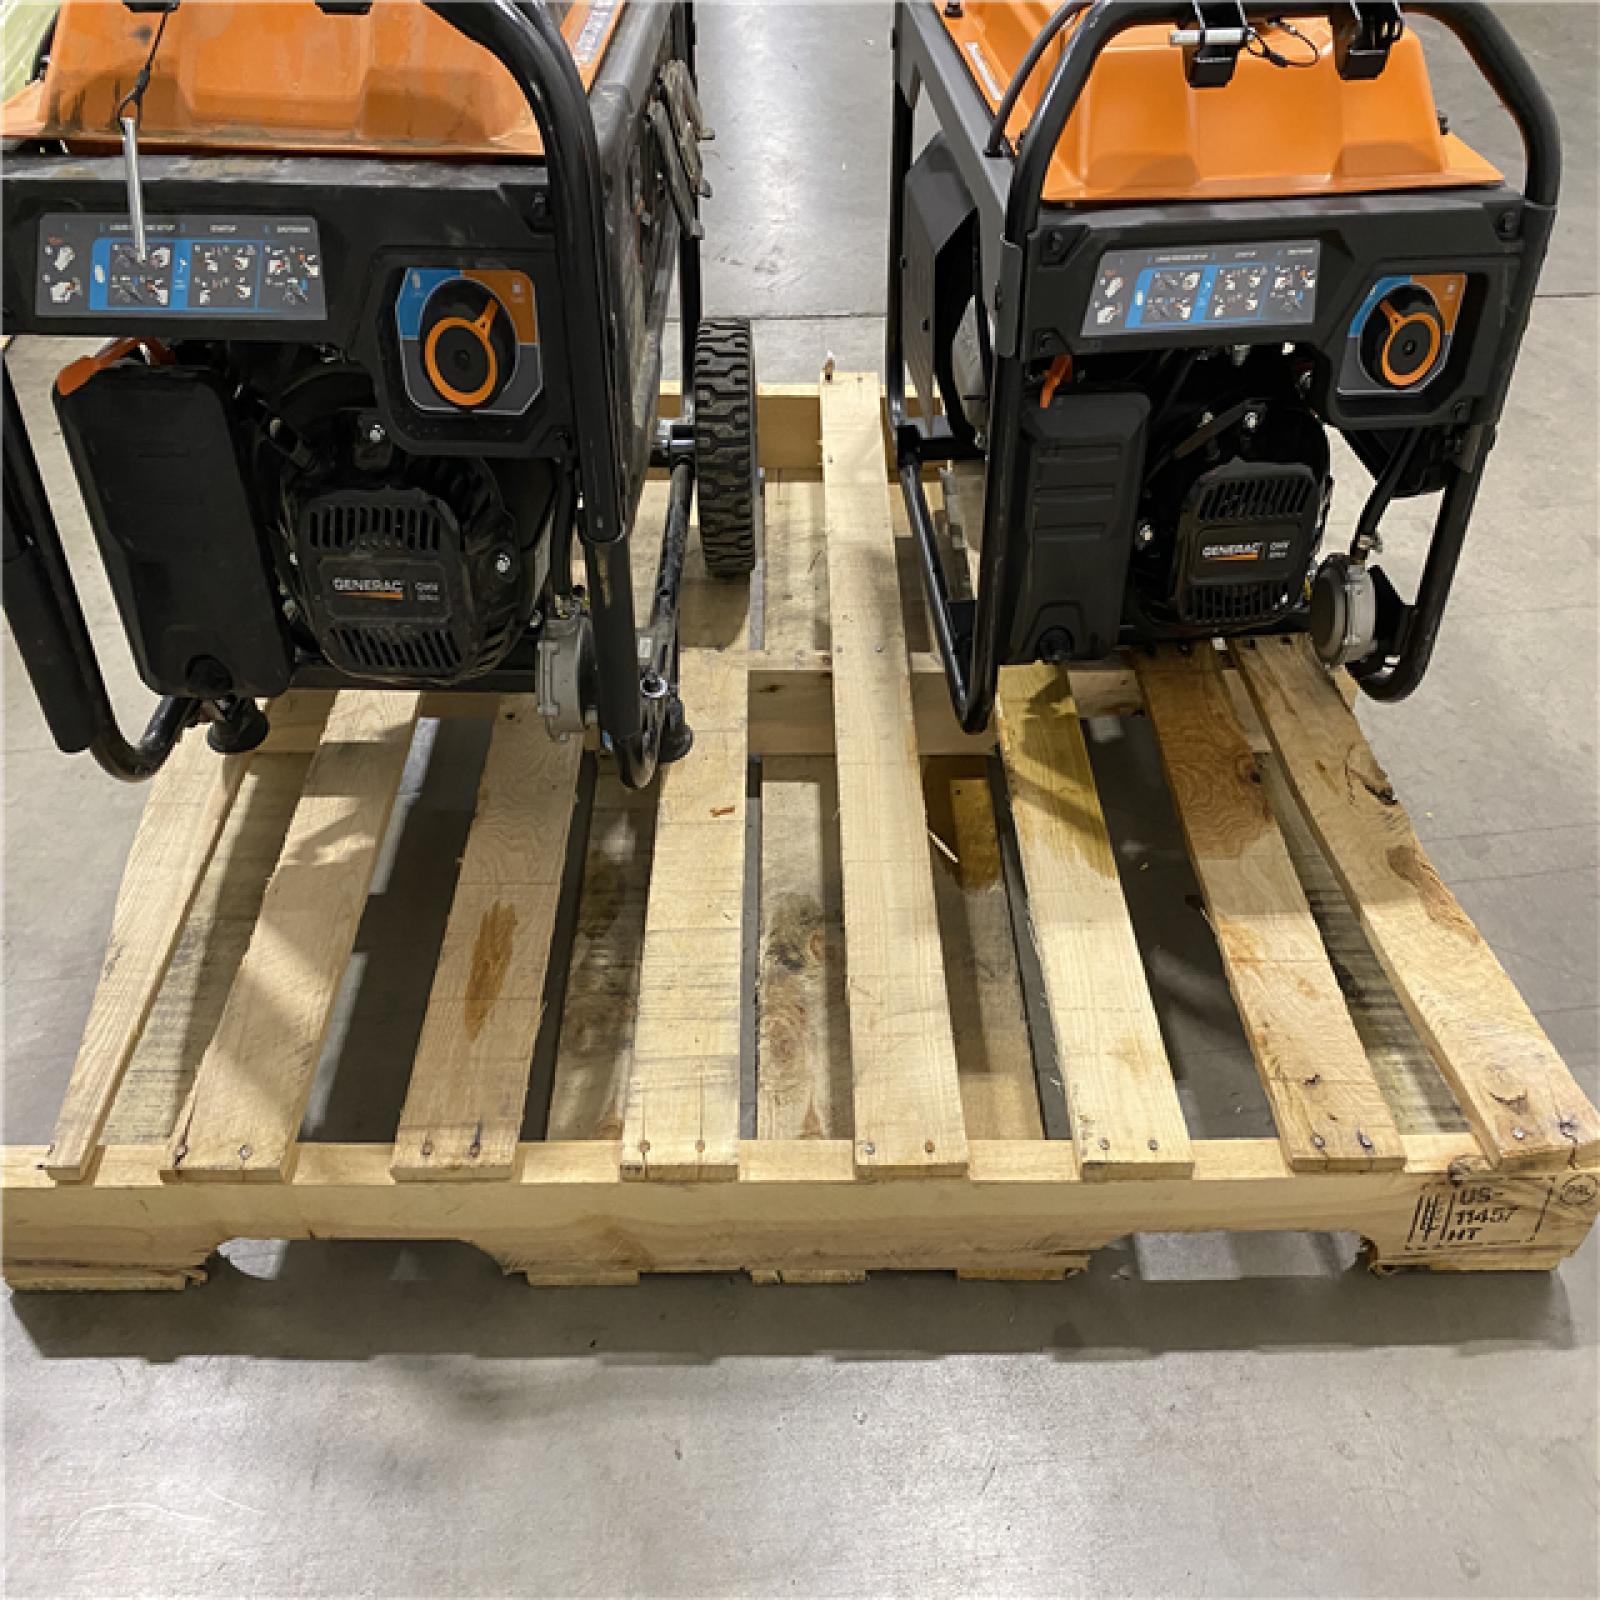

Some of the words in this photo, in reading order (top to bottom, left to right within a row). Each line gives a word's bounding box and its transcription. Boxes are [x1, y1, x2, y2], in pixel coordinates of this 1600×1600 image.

[1202, 543, 1262, 557] GENERAC
[334, 577, 403, 592] GENERAC
[1456, 1206, 1519, 1226] 11457
[1447, 1227, 1483, 1241] HT
